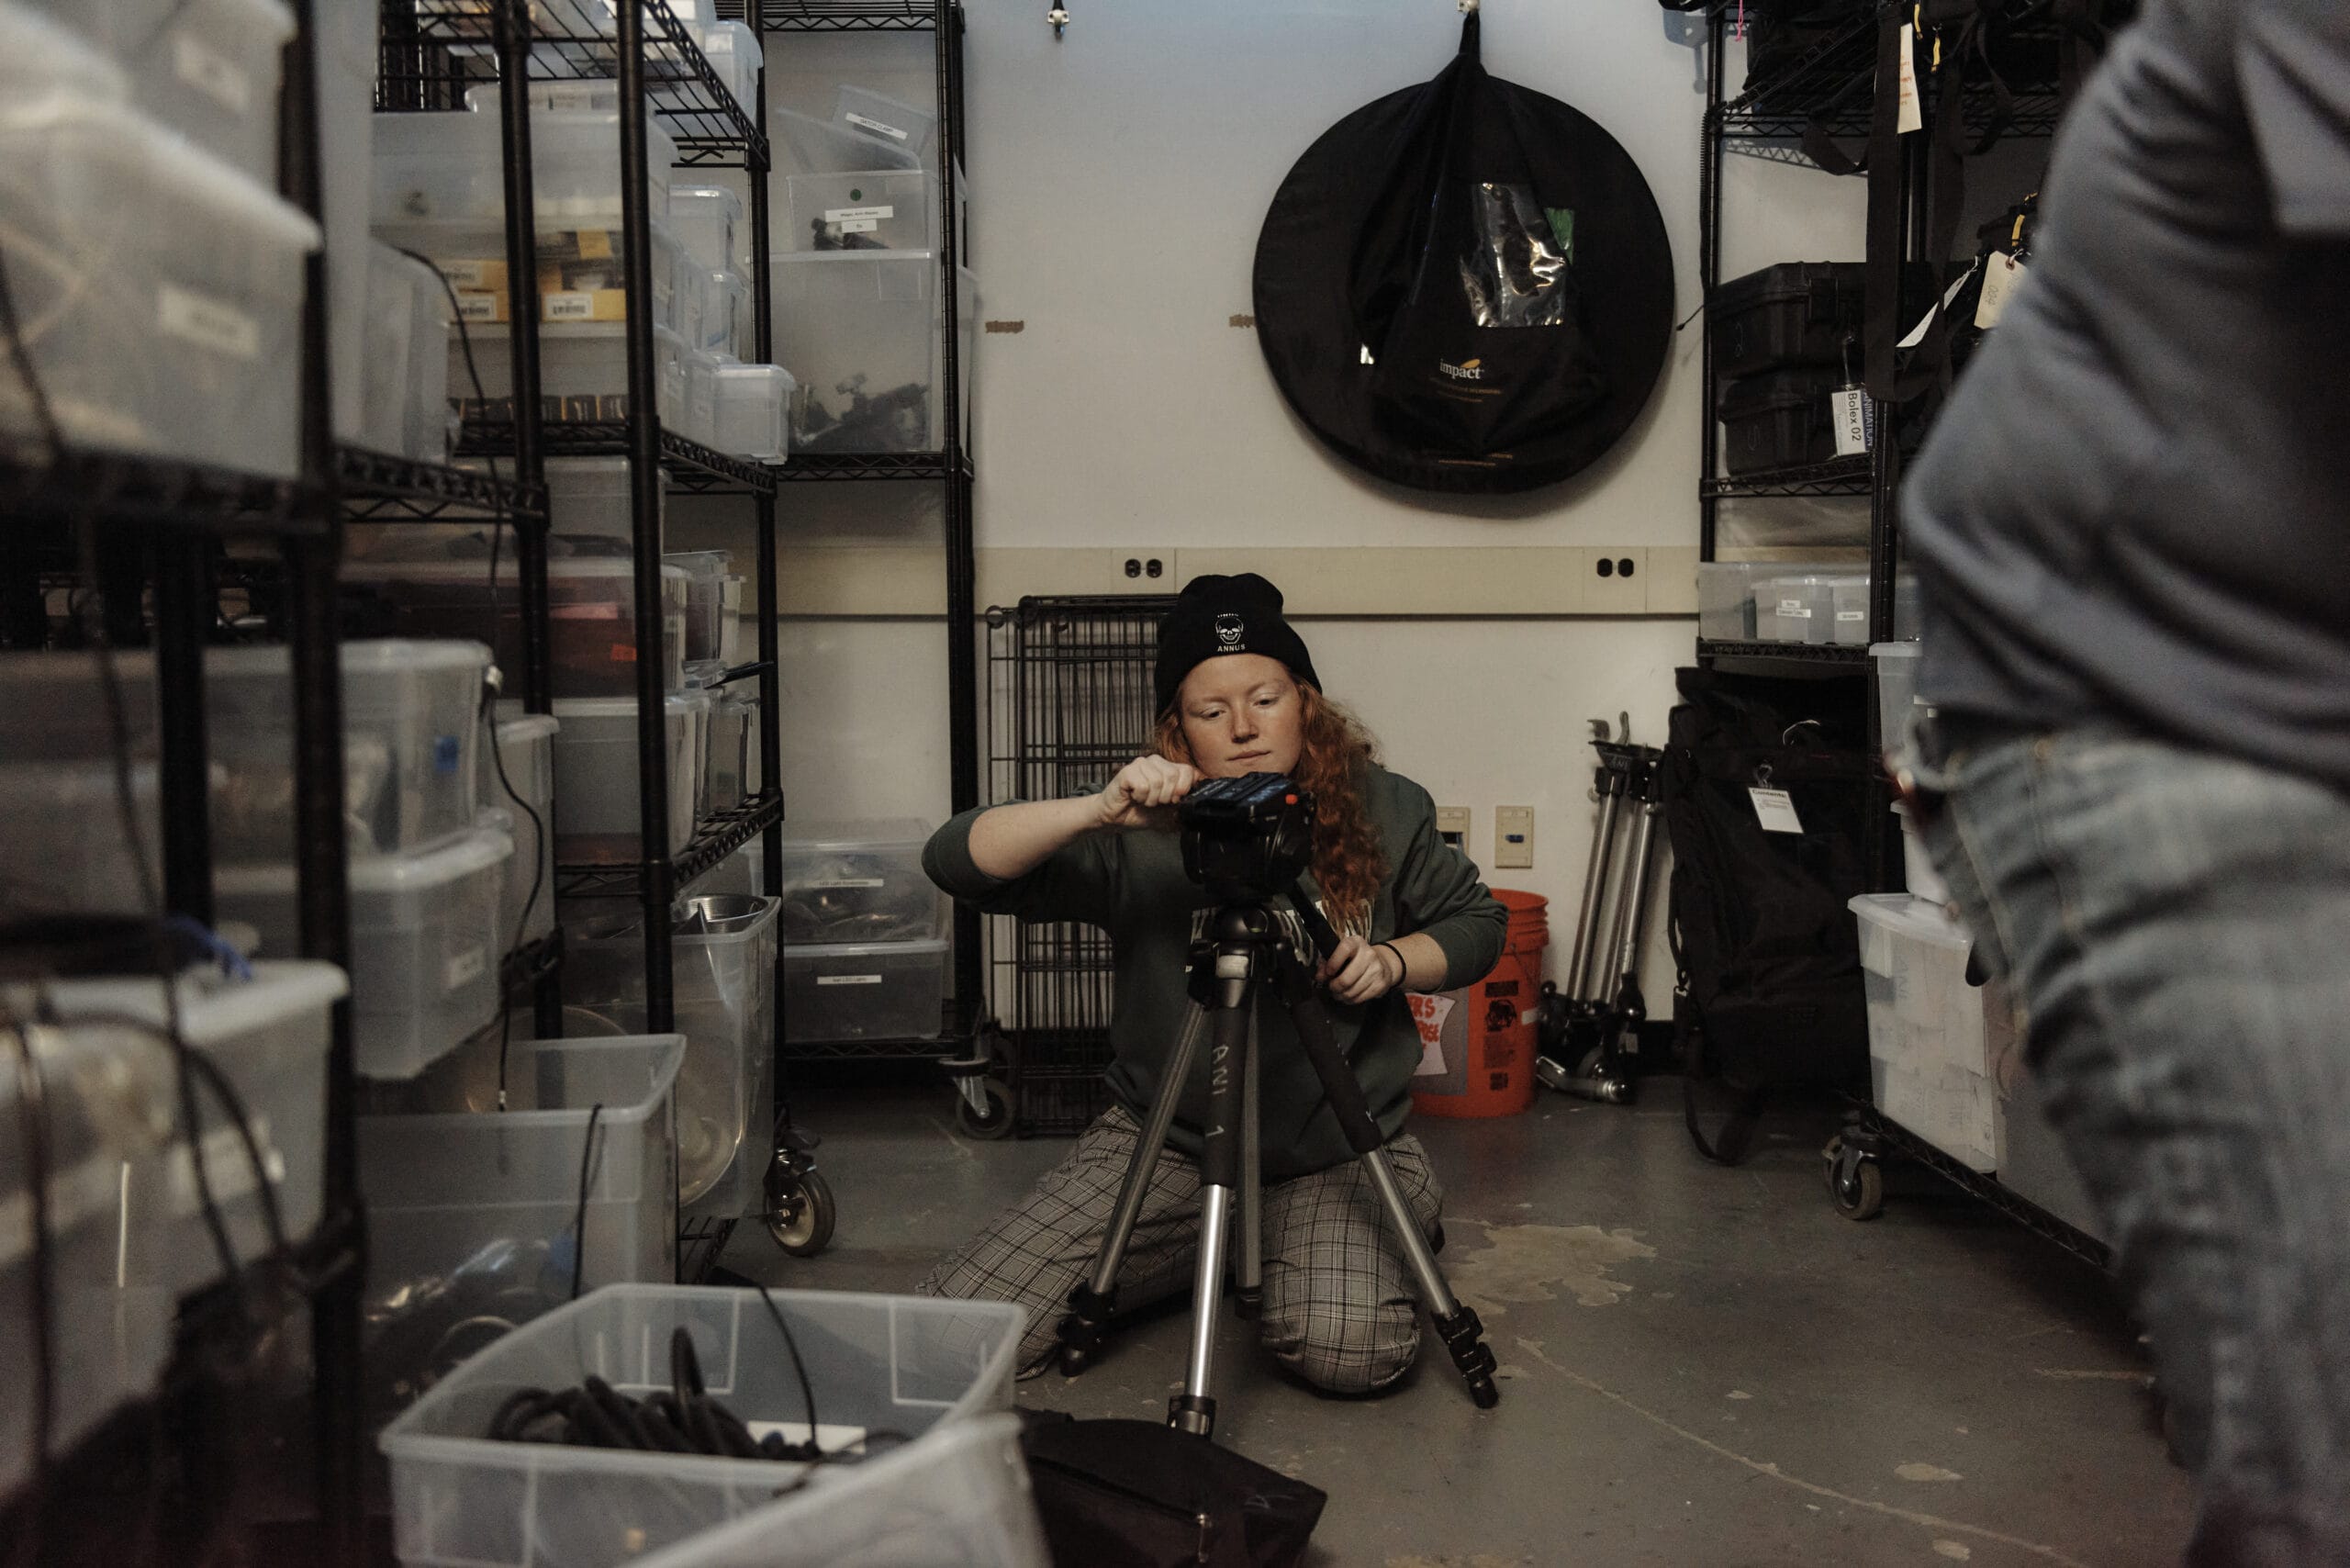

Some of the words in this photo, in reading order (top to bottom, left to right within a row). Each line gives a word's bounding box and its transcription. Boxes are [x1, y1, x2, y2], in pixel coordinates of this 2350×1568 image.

[1439, 358, 1482, 380] impact
[1848, 392, 1860, 424] Bolex
[1851, 427, 1862, 442] 02
[1217, 644, 1246, 653] ANNUS
